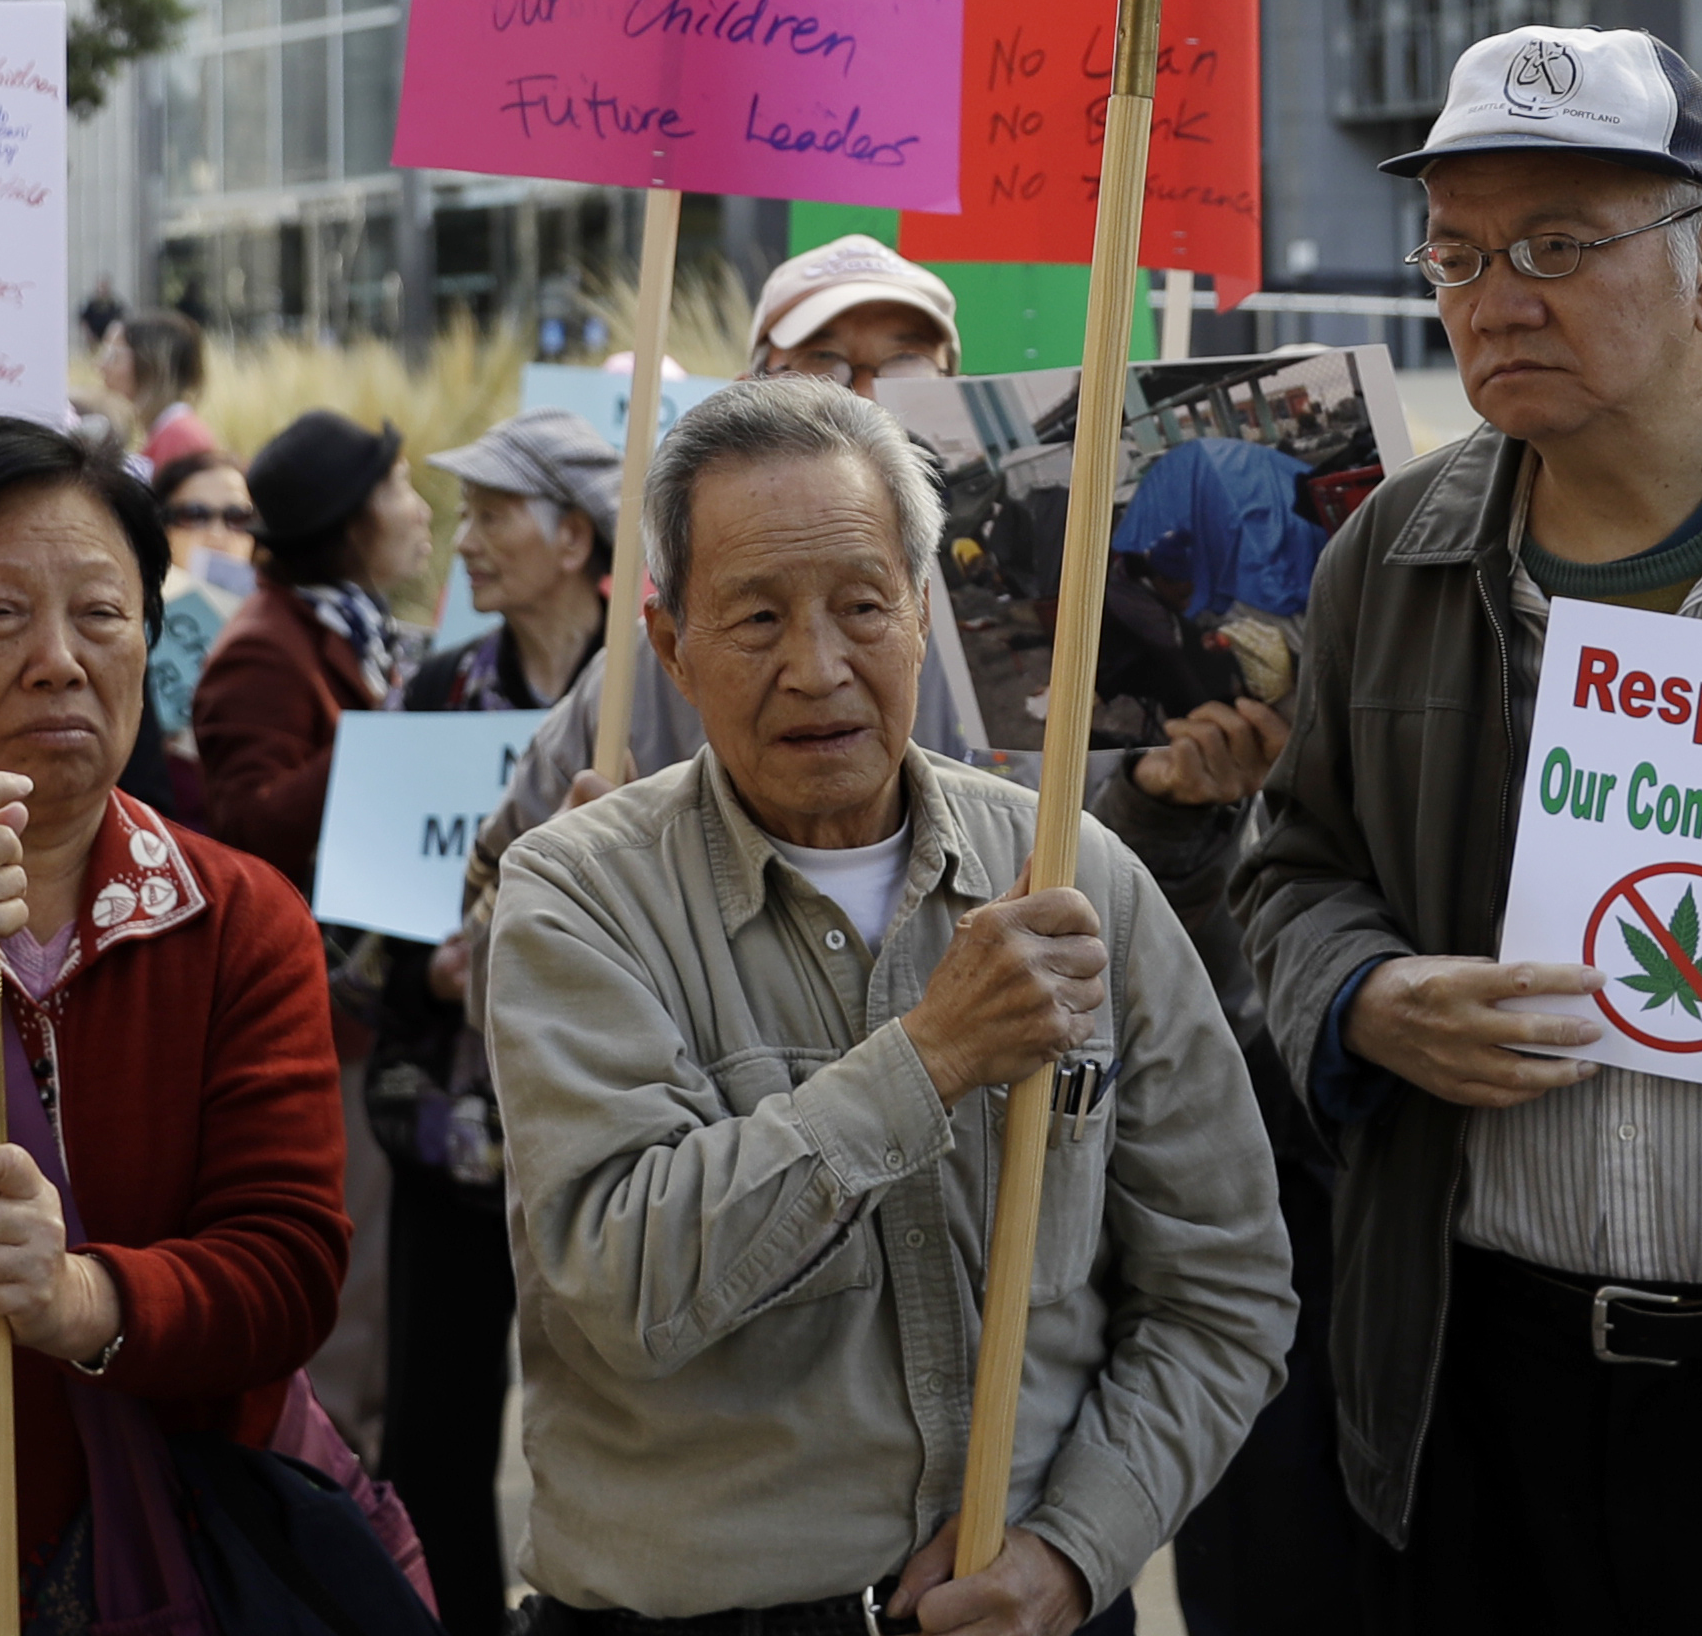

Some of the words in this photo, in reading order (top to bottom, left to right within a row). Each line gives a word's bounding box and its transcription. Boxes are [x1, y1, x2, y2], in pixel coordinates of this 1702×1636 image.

[1082, 25, 1218, 82] Lan
[1563, 108, 1621, 125] PORTLAND
[1540, 746, 1617, 822] Our
